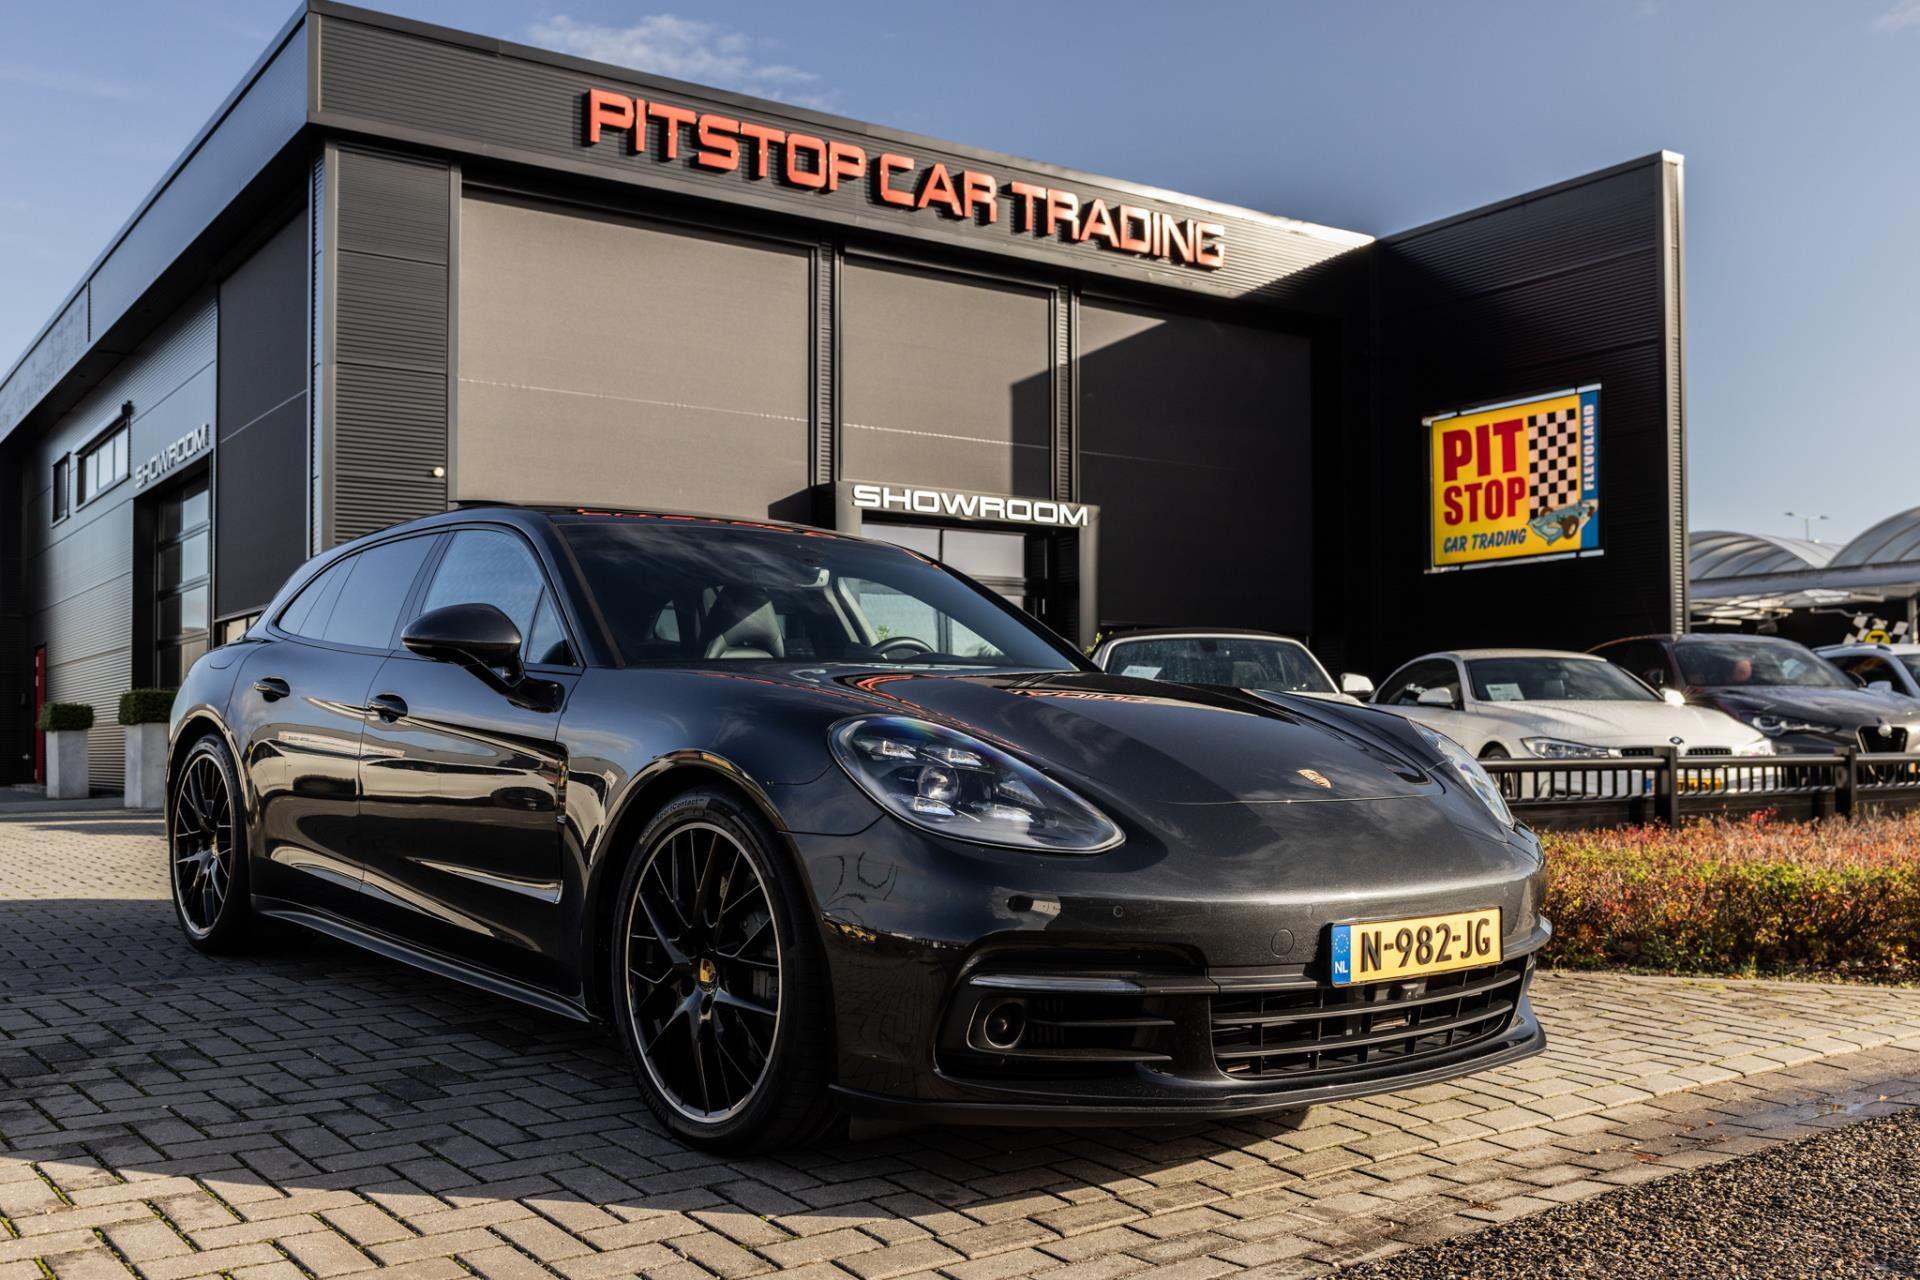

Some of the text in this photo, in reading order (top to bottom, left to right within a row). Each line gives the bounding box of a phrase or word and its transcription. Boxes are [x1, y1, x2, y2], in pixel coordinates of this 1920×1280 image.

[589, 88, 1225, 268] PITSTOP CAR TRADING
[135, 423, 210, 490] SHOWROOM
[1442, 418, 1524, 482] PIT
[1583, 404, 1595, 491] FLEVOLAND
[853, 484, 1089, 527] SHOWROOM
[1443, 476, 1526, 526] STOP
[1443, 528, 1527, 553] CAR TRADING
[1334, 961, 1349, 974] NL
[1360, 917, 1491, 973] N-982-JG
